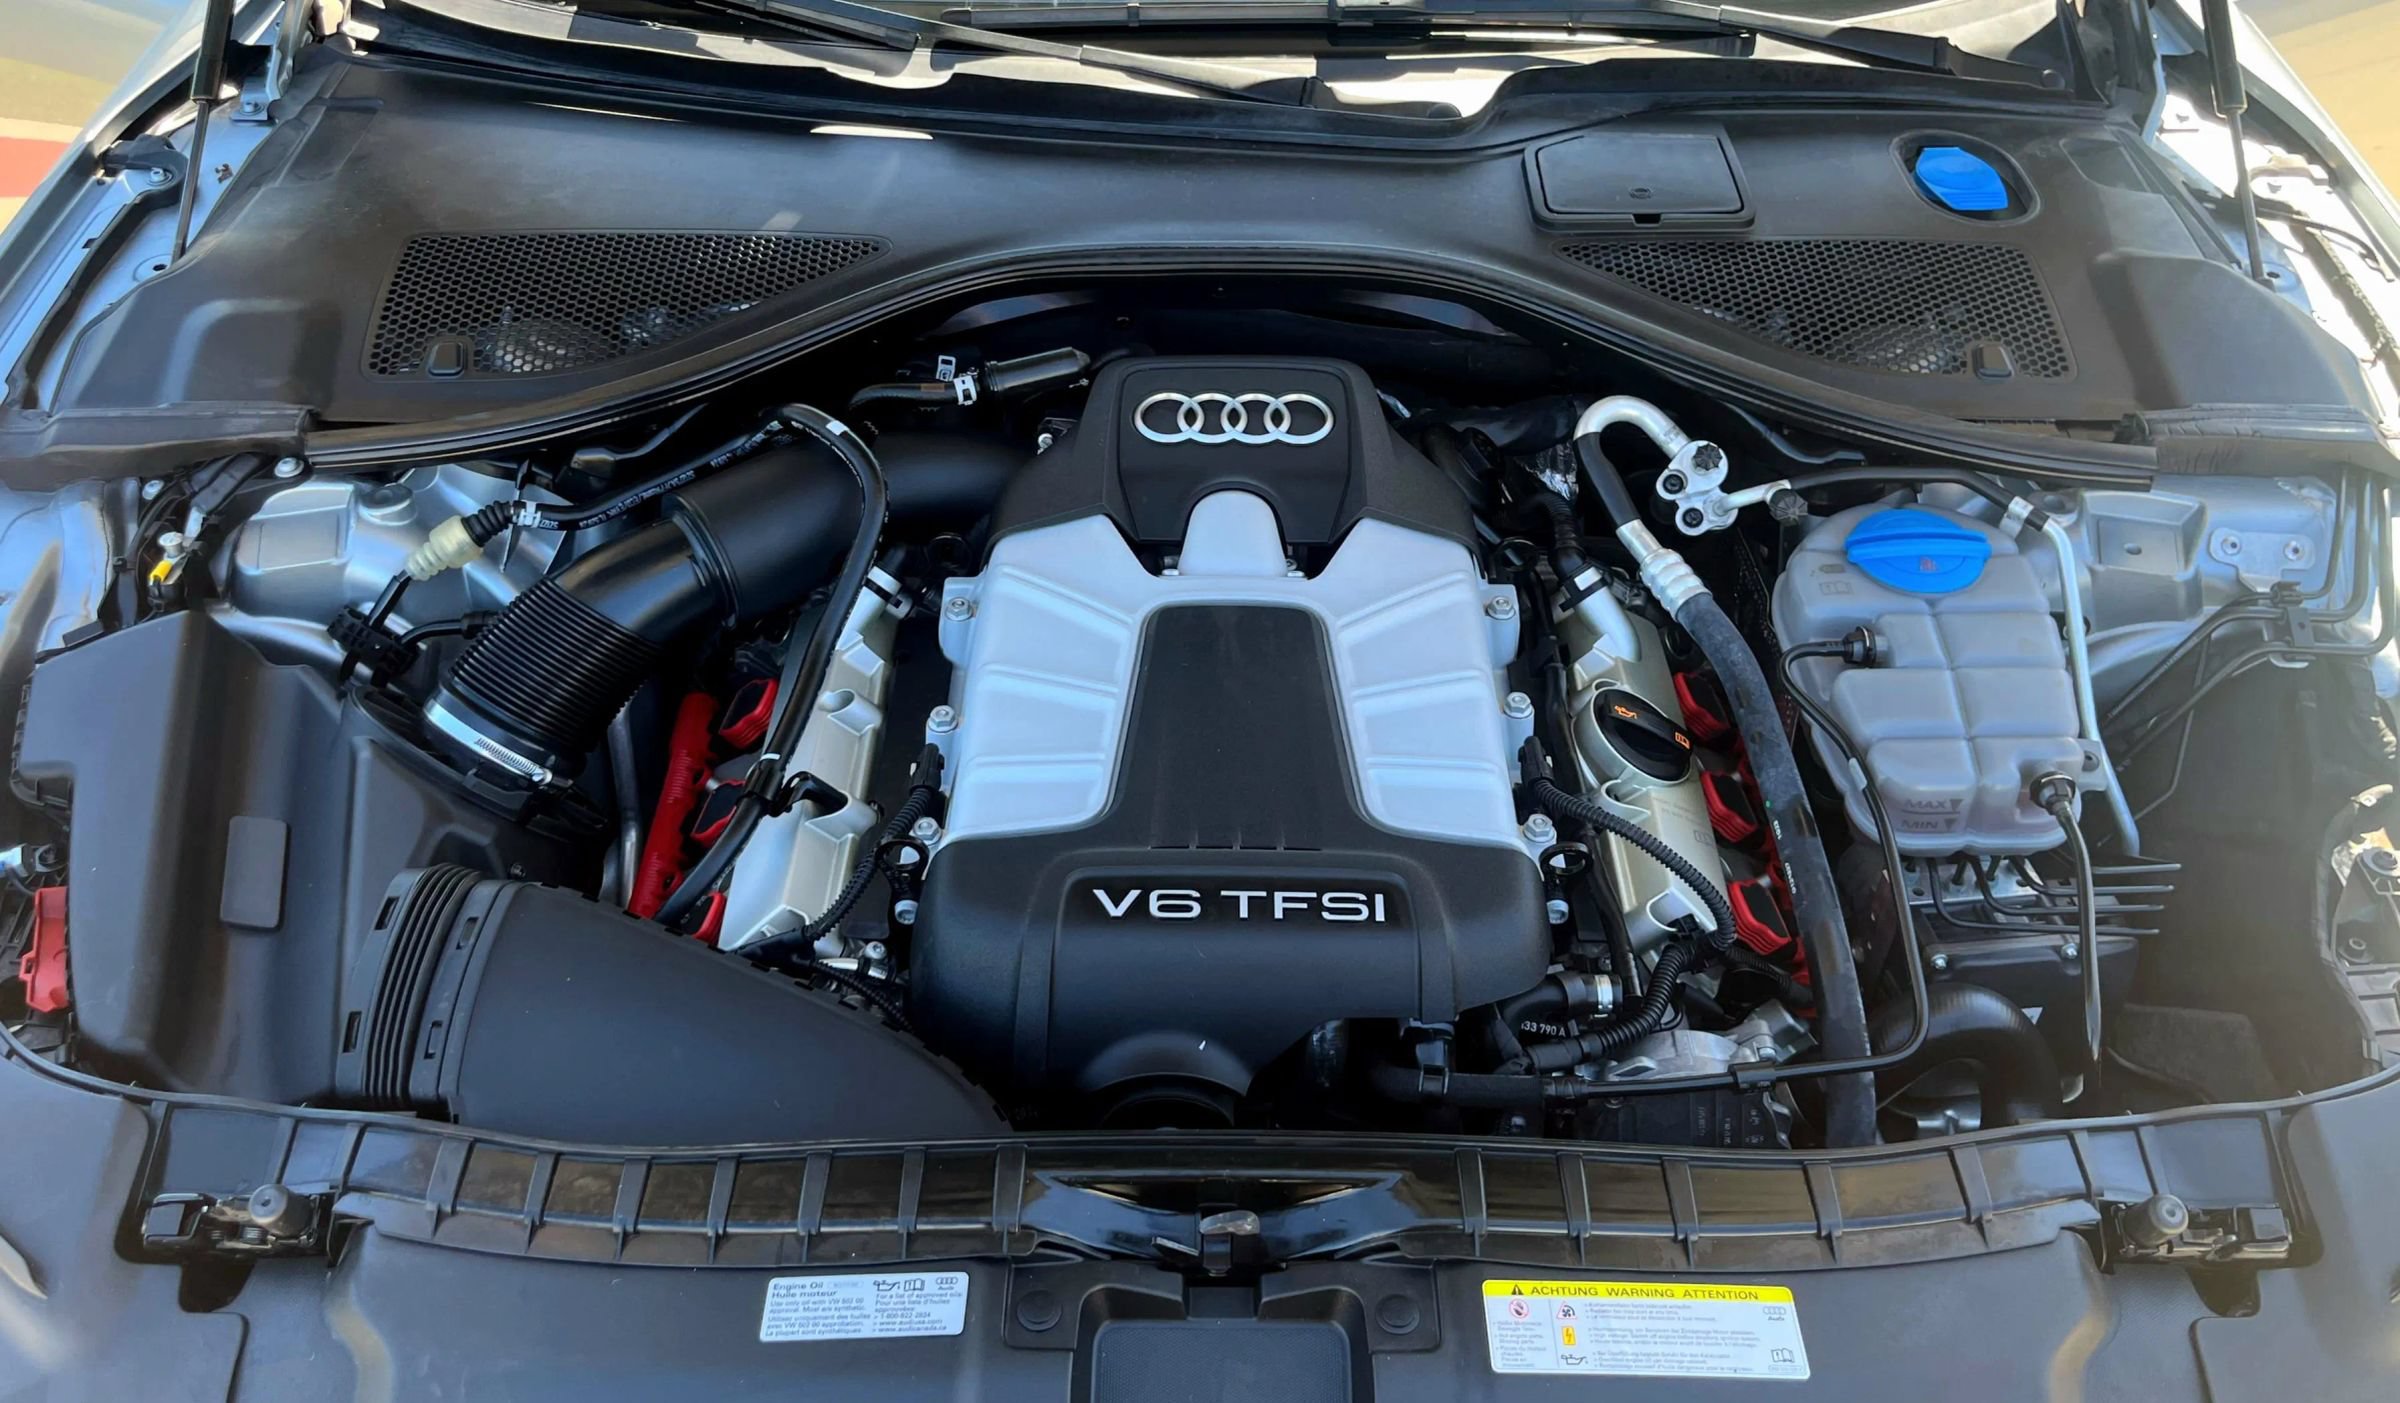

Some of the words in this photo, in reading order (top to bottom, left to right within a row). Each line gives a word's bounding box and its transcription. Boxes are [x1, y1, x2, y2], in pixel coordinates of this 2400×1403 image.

[1904, 799, 1947, 809] MAX
[1902, 820, 1938, 829] MIN
[1092, 889, 1201, 918] V6
[1220, 890, 1386, 922] TFSI
[1540, 1024, 1557, 1036] 790
[1559, 1027, 1566, 1038] A
[773, 1282, 807, 1292] Engine
[809, 1281, 824, 1289] Oil
[771, 1290, 797, 1298] Huile
[799, 1290, 838, 1298] moteur
[1531, 1286, 1598, 1296] ACHTUNG
[1606, 1288, 1675, 1298] WARNING
[1683, 1289, 1759, 1300] ATTENTION
